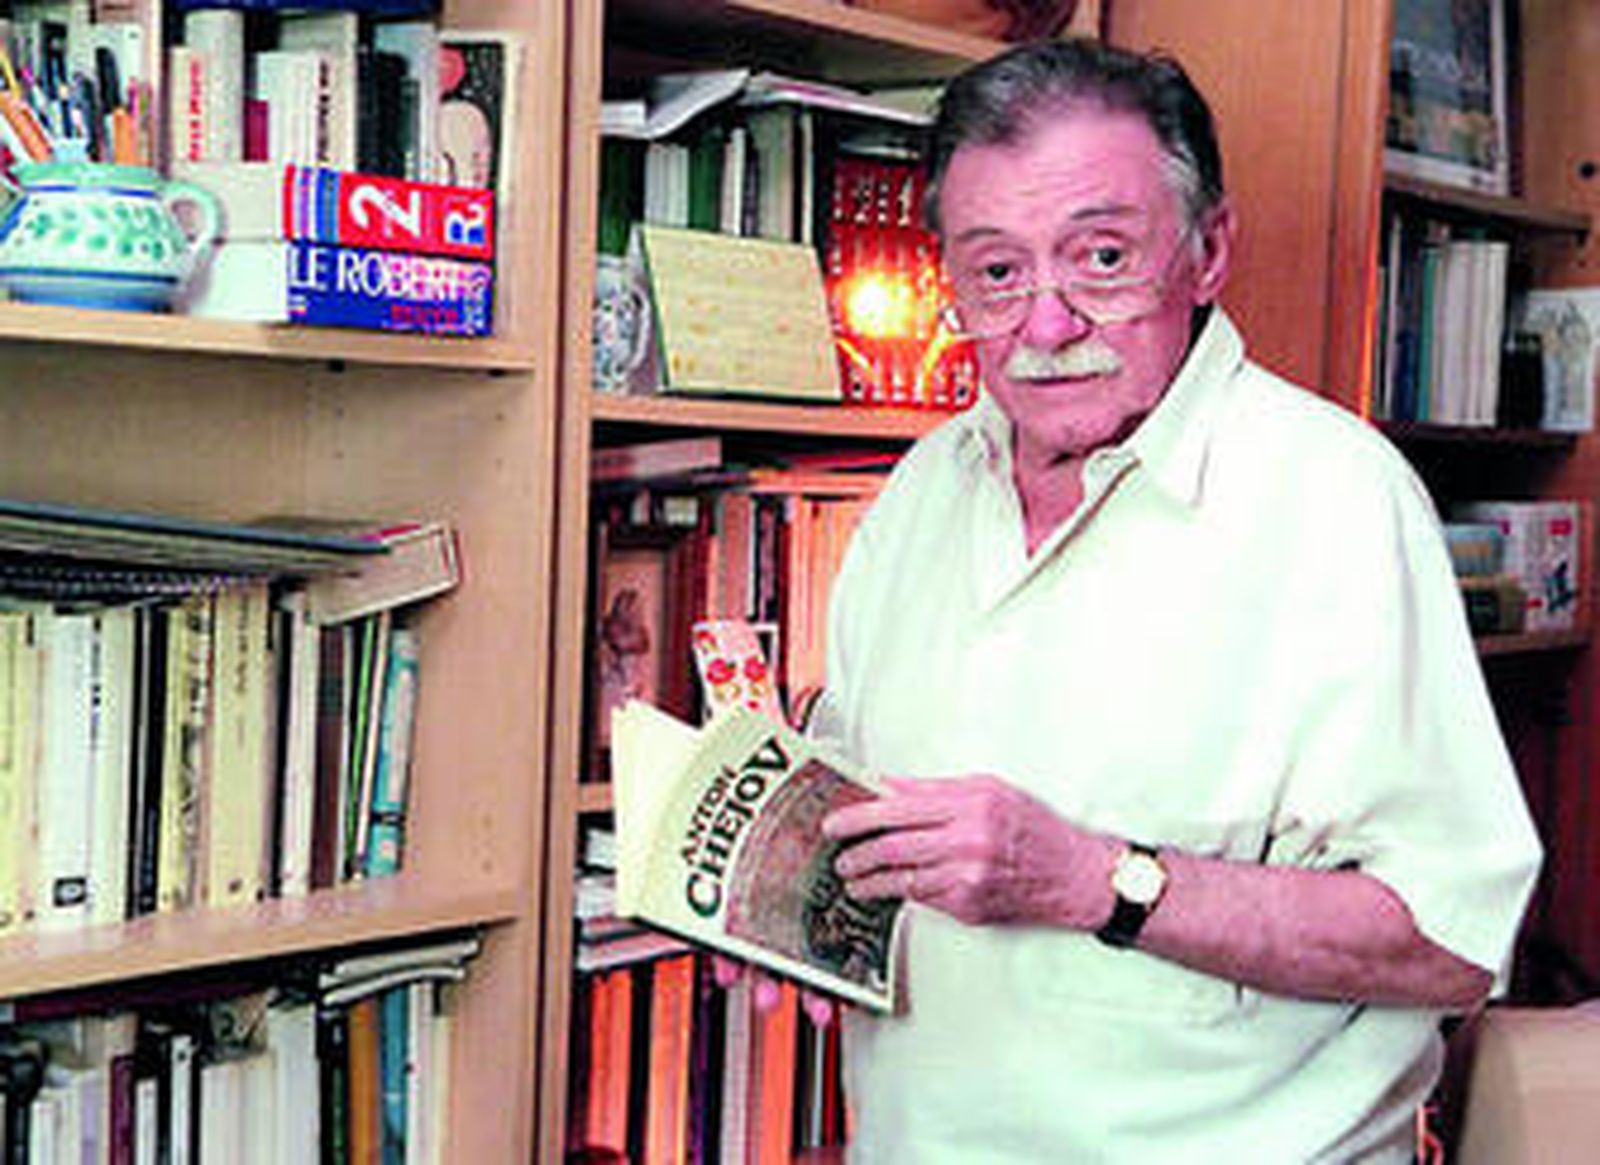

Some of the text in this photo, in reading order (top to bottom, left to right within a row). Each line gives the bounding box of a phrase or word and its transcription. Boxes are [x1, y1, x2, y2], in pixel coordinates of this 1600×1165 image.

[350, 184, 421, 237] 2
[289, 247, 327, 292] LE
[337, 252, 469, 302] ROBERT
[686, 736, 789, 917] CHEJOV
